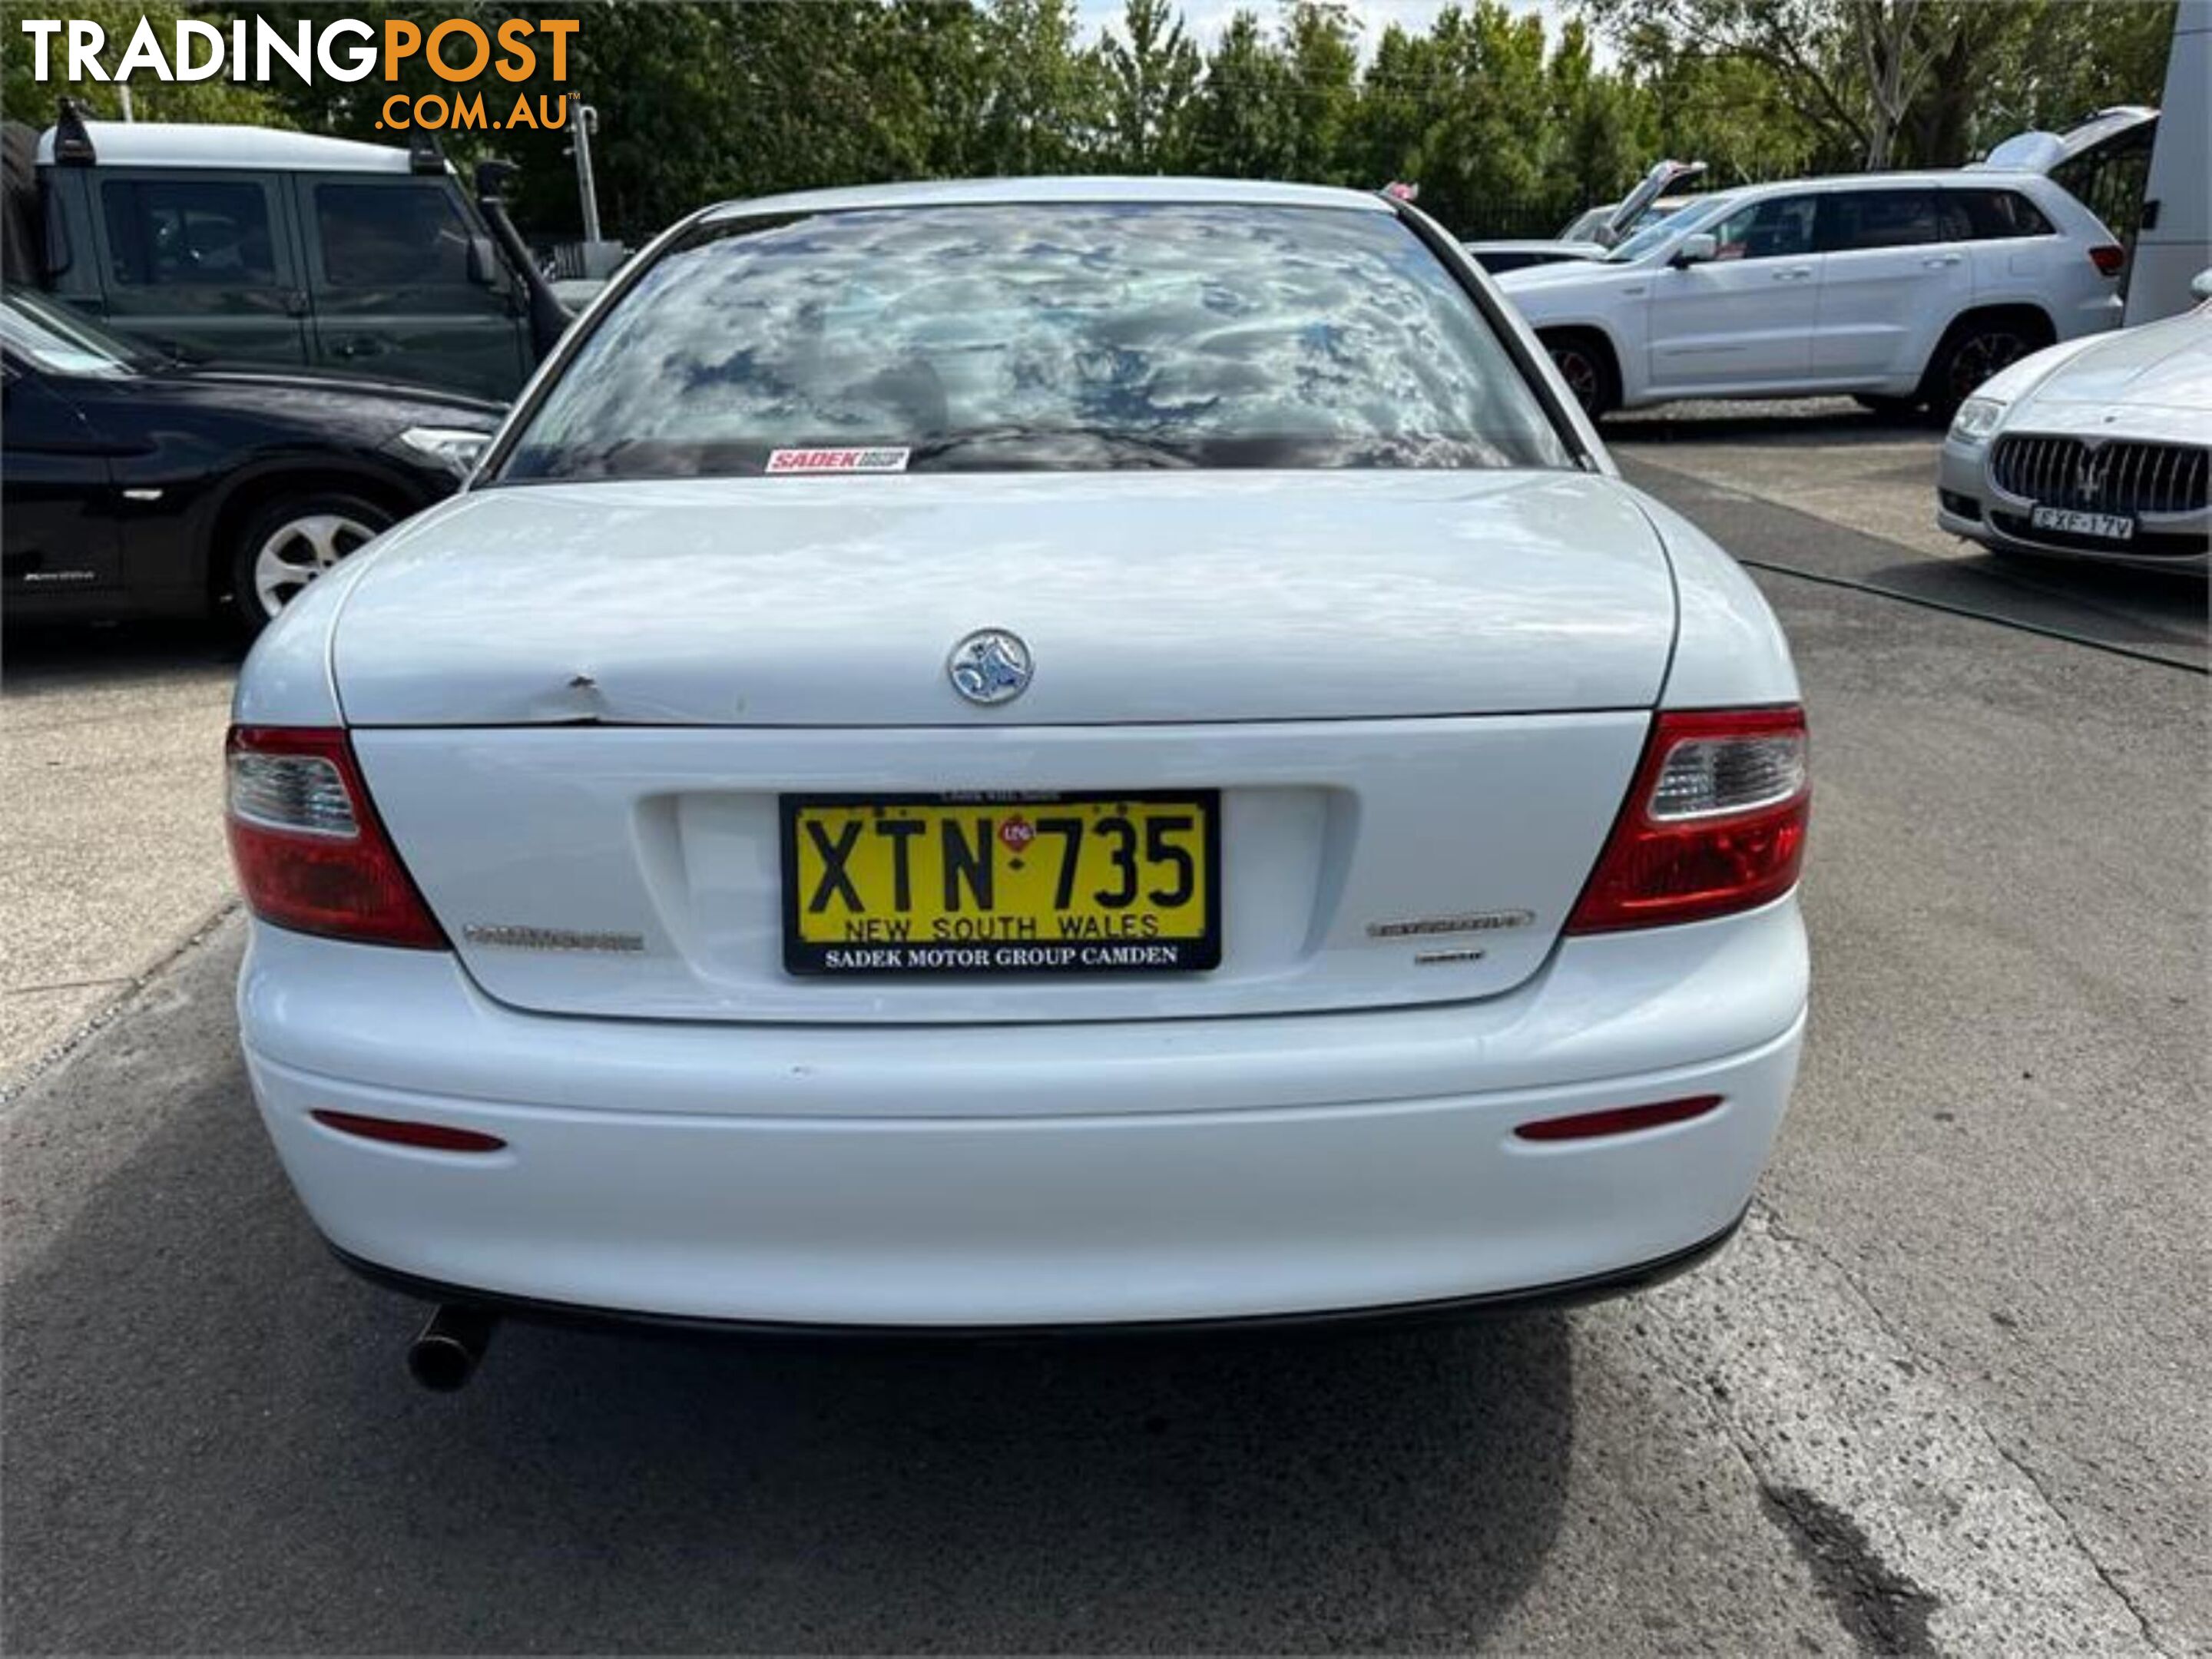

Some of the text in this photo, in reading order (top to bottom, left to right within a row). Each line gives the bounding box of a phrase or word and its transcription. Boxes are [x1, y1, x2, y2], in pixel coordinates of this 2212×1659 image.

[773, 452, 859, 469] SADEK
[805, 816, 1194, 914] XTN 735
[846, 914, 1159, 941] NEW SOUTH WALES
[826, 945, 1177, 968] SADEK MOTOR GROUP CAMDEN
